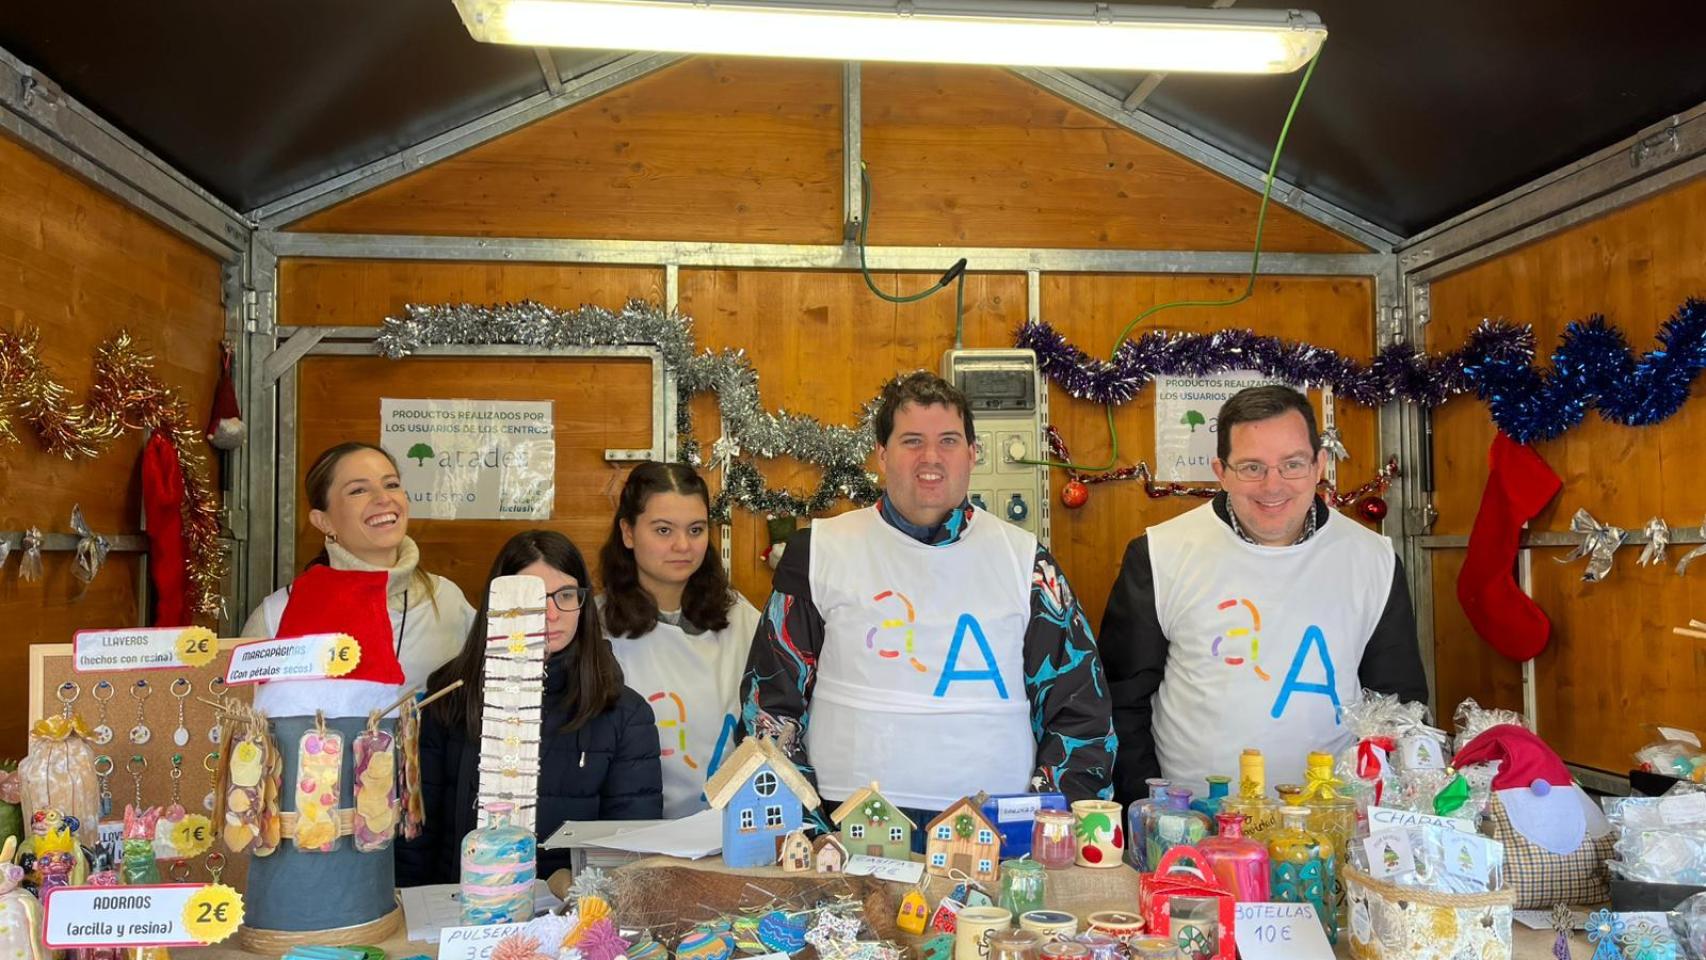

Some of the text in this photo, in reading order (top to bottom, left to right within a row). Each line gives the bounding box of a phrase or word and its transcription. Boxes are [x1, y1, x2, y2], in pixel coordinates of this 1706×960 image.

[1165, 380, 1222, 388] PRODUCTOS
[392, 410, 544, 420] PRODUCTOS REALIZADOS POR
[385, 424, 548, 434] LOS USUARIOS DE LOS CENTROS
[438, 444, 528, 468] atade
[1176, 456, 1210, 467] Auti
[102, 635, 149, 647] LLAVEROS
[185, 639, 209, 654] 2€
[80, 652, 173, 665] (hechos con resina)
[328, 646, 350, 661] 1€
[933, 613, 1009, 699] A
[230, 663, 312, 680] (Con pétalos secos)
[1271, 625, 1341, 725] A
[1374, 811, 1457, 830] CHAPAS
[182, 826, 205, 842] 1€
[93, 896, 152, 910] ADORNOS
[196, 902, 230, 922] 2€
[1235, 904, 1313, 920] BOTELLAS
[67, 921, 173, 937] (arcilla y resina)
[448, 926, 526, 942] PULSERA
